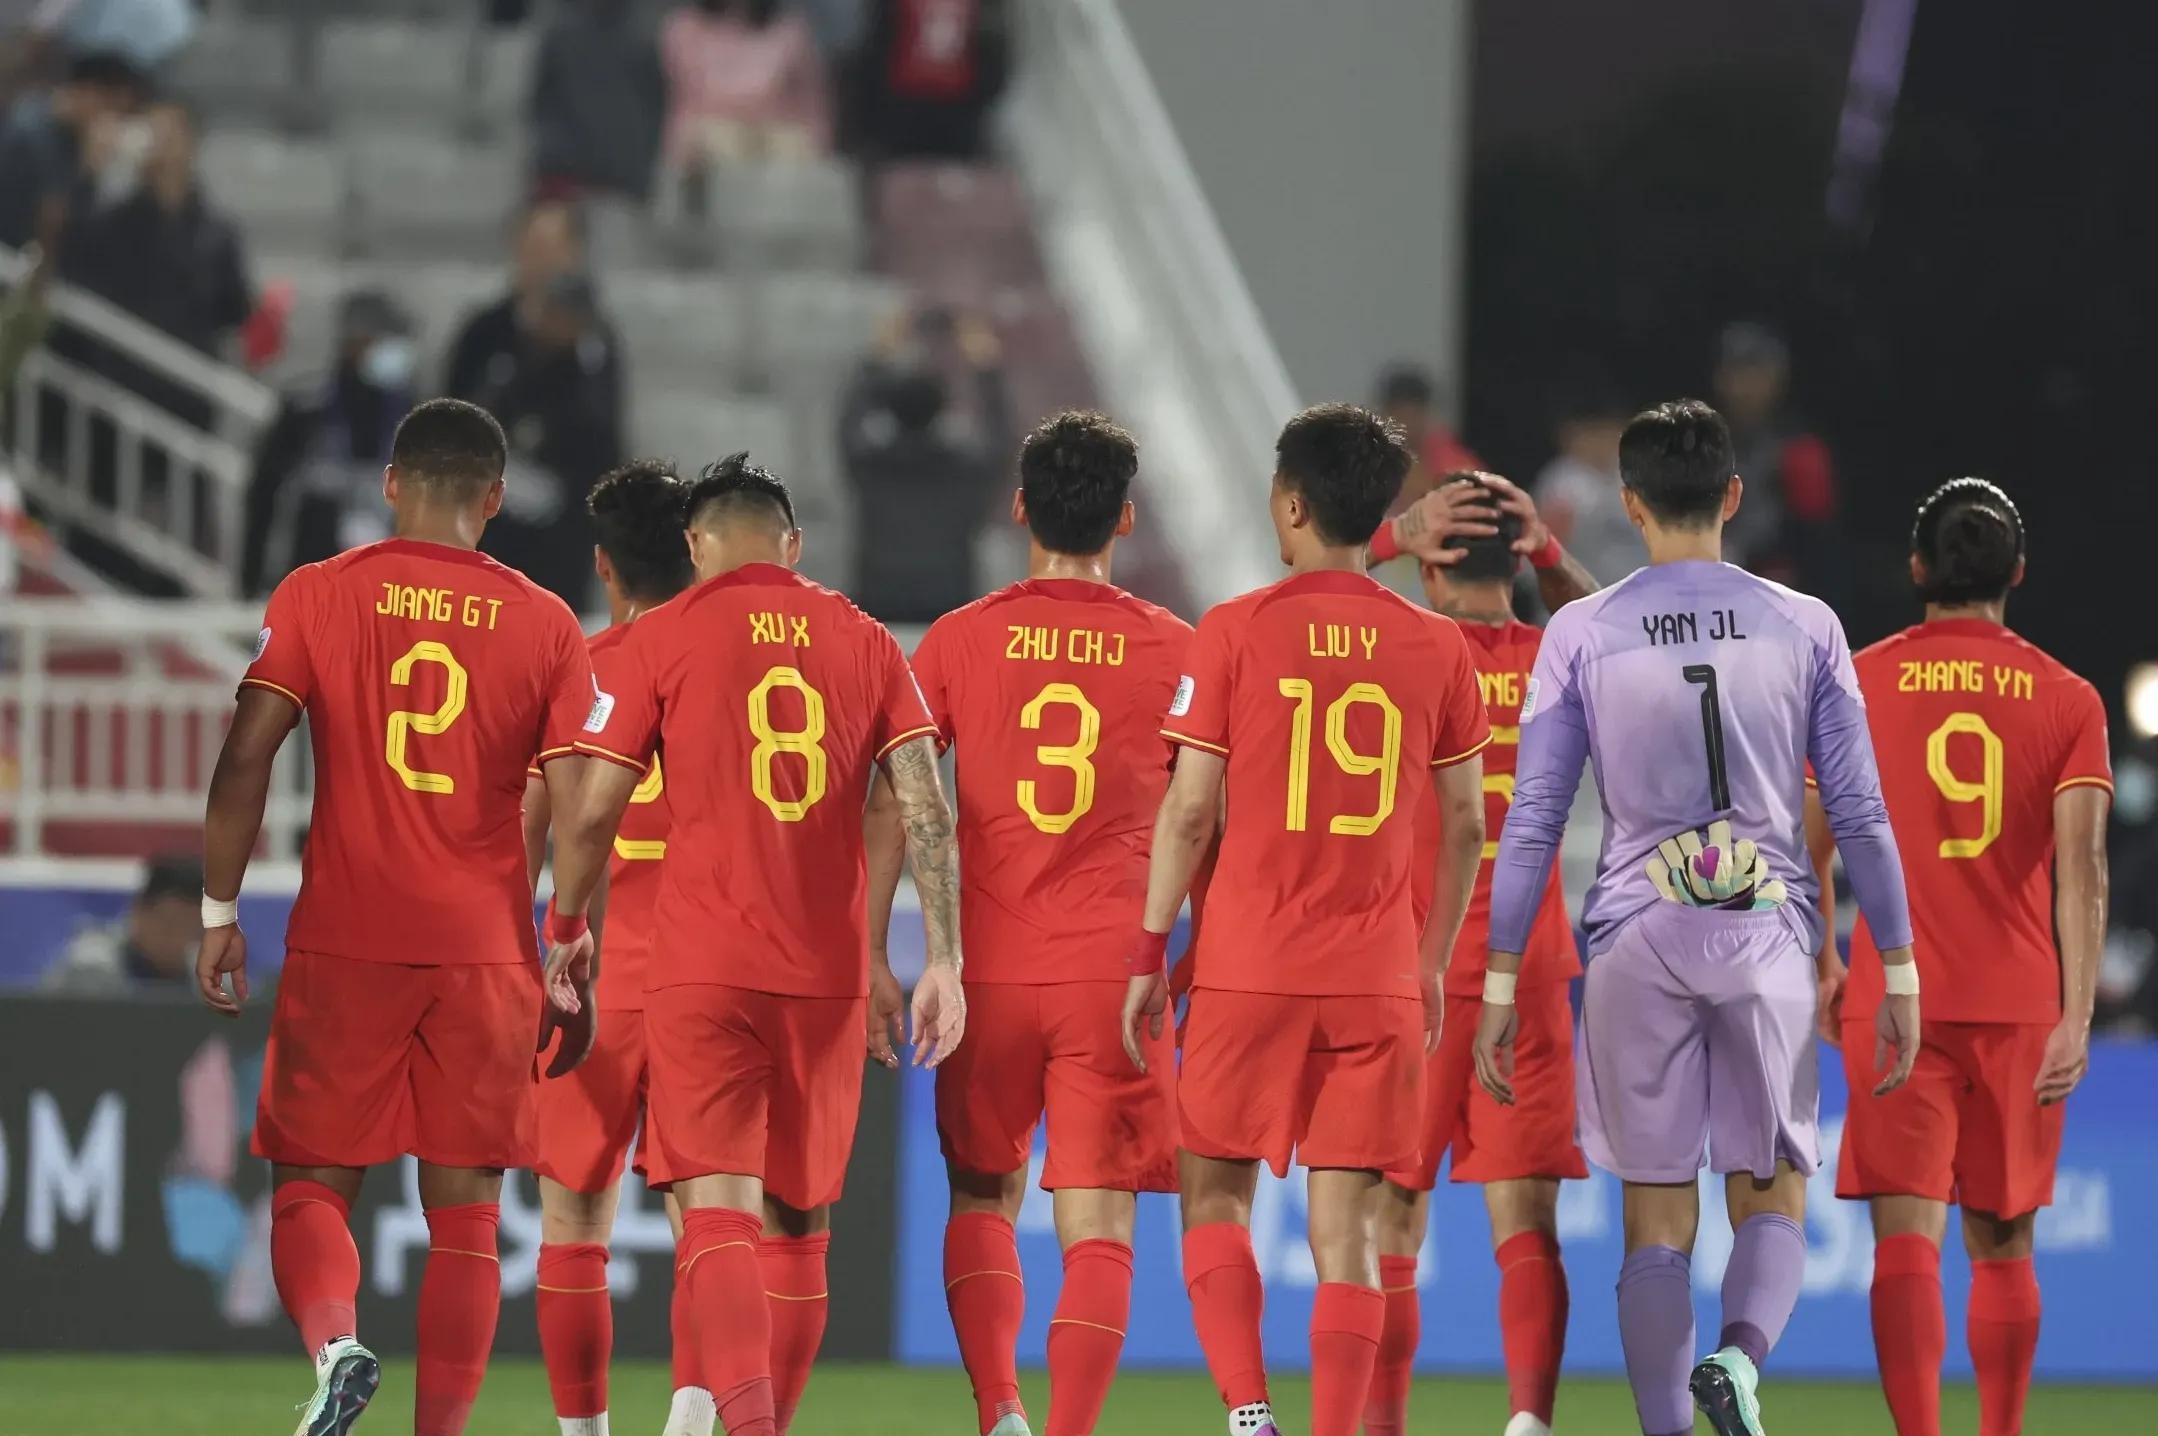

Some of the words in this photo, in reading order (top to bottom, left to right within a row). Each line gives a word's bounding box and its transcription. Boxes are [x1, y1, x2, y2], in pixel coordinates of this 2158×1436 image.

[376, 582, 454, 622] JIANG
[749, 611, 786, 644] XU
[790, 616, 810, 647] X
[1005, 625, 1059, 661] ZHU
[1308, 623, 1350, 658] LIU
[1360, 626, 1377, 660] Y
[1642, 612, 1697, 645] YAN
[1709, 609, 1746, 640] JL
[385, 640, 468, 795] 2
[1475, 671, 1520, 707] NG
[1898, 660, 1984, 693] ZHANG
[1994, 665, 2034, 700] YN
[747, 666, 827, 822] 8
[1016, 682, 1101, 834] 3
[1278, 678, 1402, 836] 19
[1682, 664, 1731, 811] 1
[1926, 712, 2004, 859] 9
[0, 1086, 126, 1253] M
